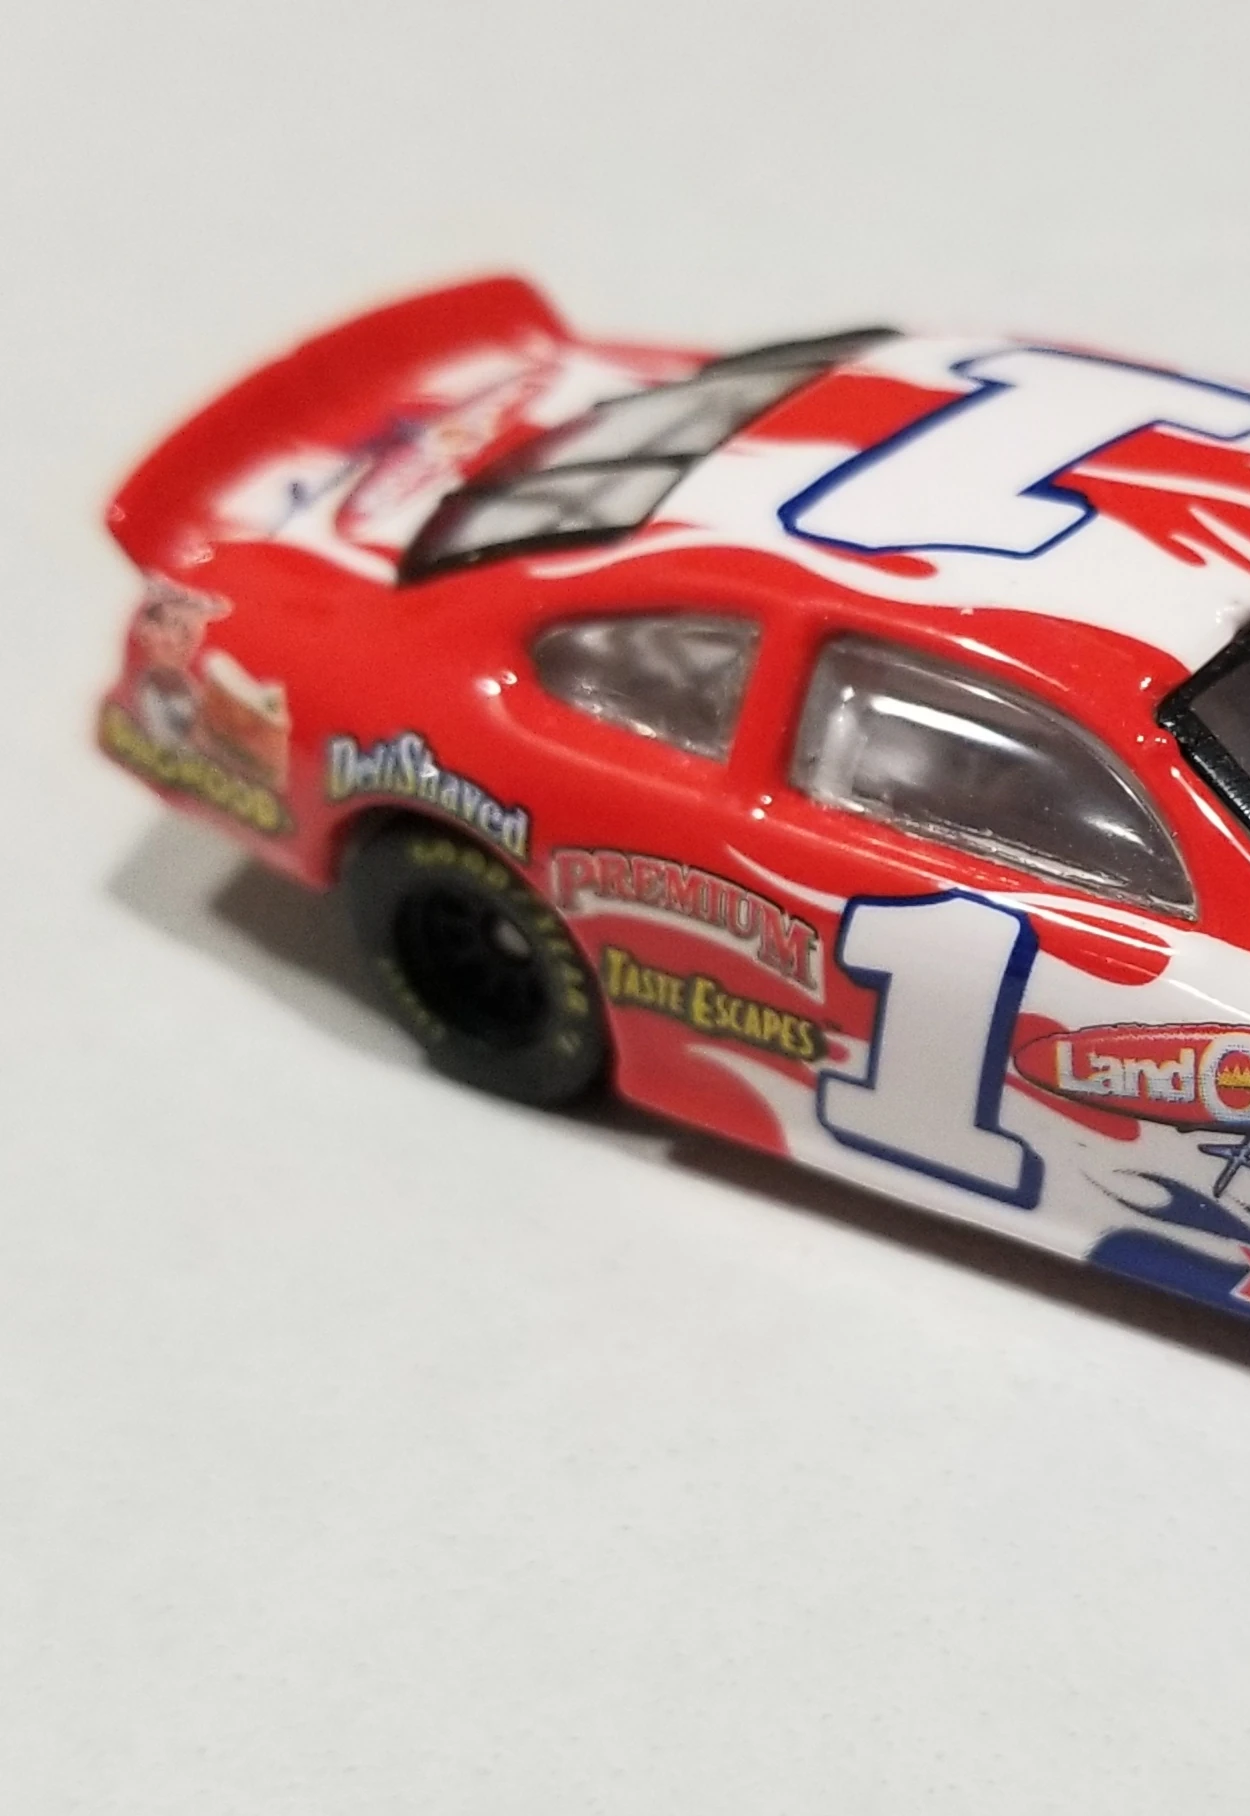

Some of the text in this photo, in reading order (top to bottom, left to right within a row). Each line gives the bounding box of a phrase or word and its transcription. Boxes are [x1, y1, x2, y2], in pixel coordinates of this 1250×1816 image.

[552, 849, 822, 998] PREMIUM
[604, 948, 814, 1055] TASTE ESCAPES
[816, 887, 1044, 1209] 1
[1055, 1040, 1196, 1103] Land
